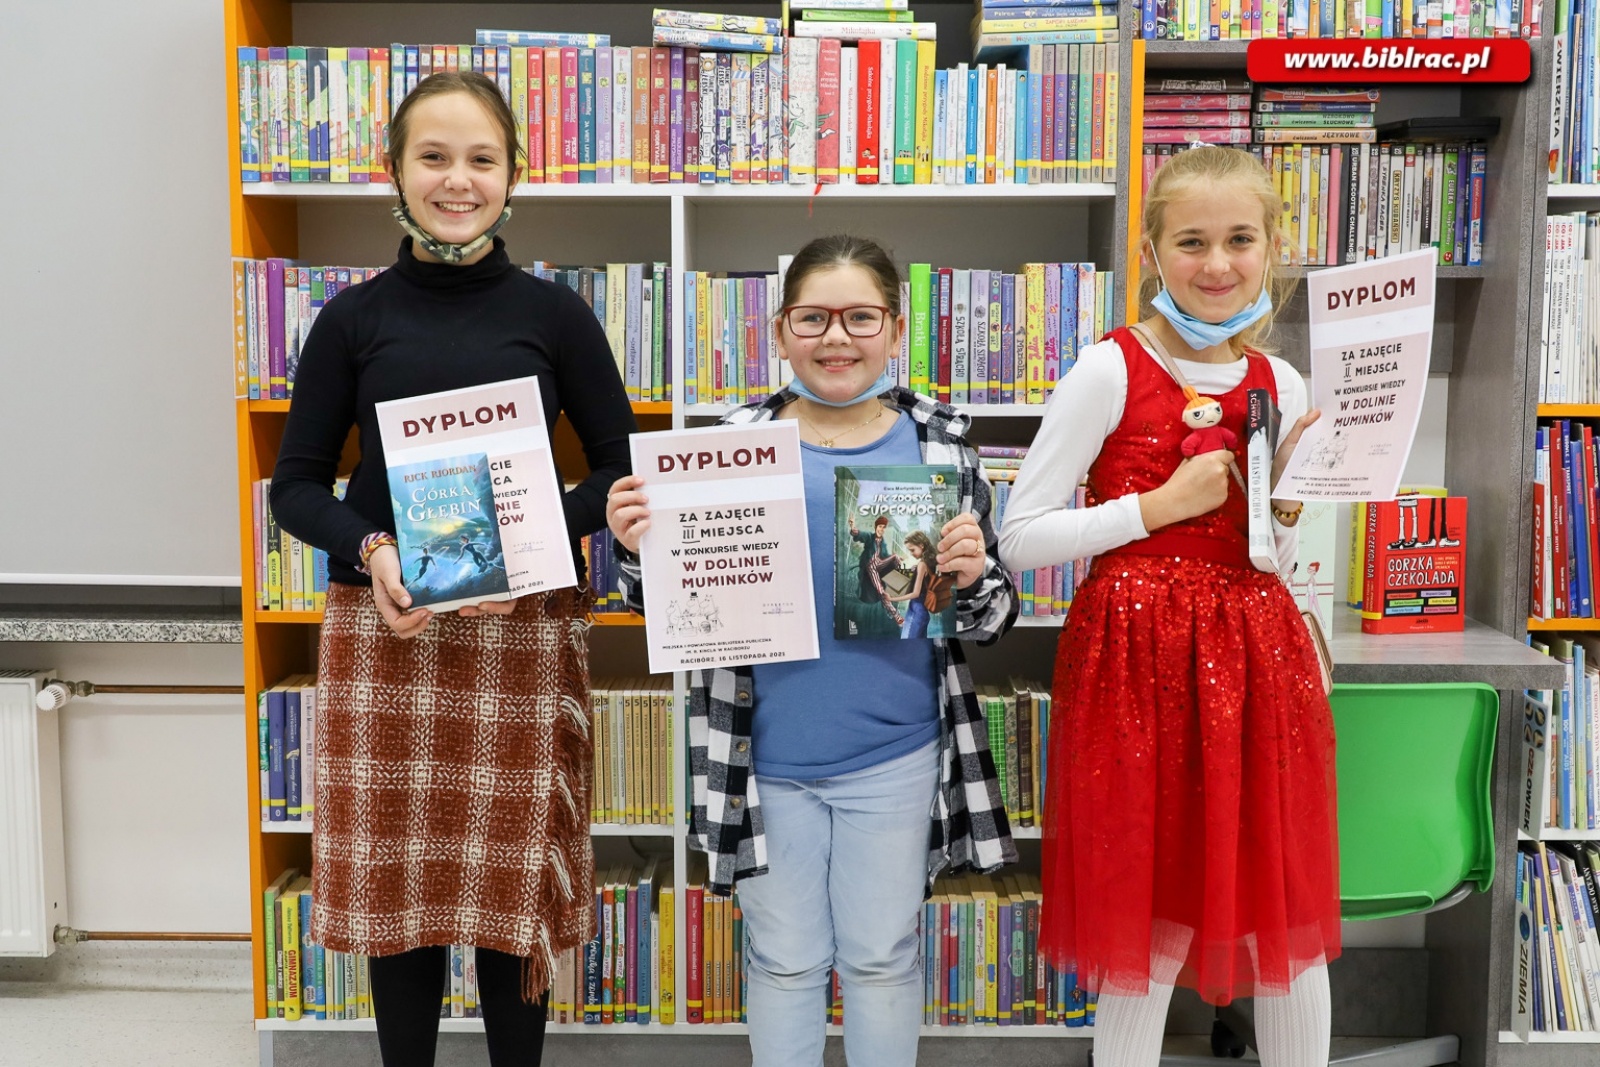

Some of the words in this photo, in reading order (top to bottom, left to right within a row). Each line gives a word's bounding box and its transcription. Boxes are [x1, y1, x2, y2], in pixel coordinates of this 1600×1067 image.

[865, 88, 873, 113] przygody
[1553, 39, 1564, 138] ZWIERZĘTA
[920, 91, 928, 116] przygody
[1069, 98, 1077, 115] życie
[865, 113, 873, 140] Mikołajka
[1321, 131, 1360, 139] JĘZYKOWE
[1069, 137, 1077, 157] NINJA
[1393, 173, 1401, 202] KRYZYS
[1447, 179, 1455, 205] EUREKA
[1392, 203, 1400, 241] KUBAŃSKI
[286, 270, 296, 284] 3
[300, 271, 310, 285] 2
[313, 271, 323, 282] 4
[326, 271, 336, 282] 5
[338, 271, 348, 283] 6
[352, 273, 362, 284] 7
[234, 270, 245, 316] LAT
[1327, 277, 1416, 311] DYPLOM
[697, 310, 705, 326] Milly
[914, 311, 927, 347] Bratki
[955, 316, 966, 344] SZKOŁA
[976, 321, 986, 348] SZKOŁA
[235, 325, 247, 387] 12-14
[1015, 339, 1025, 380] Mariolka
[1029, 336, 1040, 362] Julia
[1045, 336, 1057, 362] Julia
[1064, 336, 1076, 362] Julia
[1341, 350, 1355, 362] ZA
[1359, 343, 1402, 358] ZAJĘCIE
[955, 347, 967, 378] STRACHU
[976, 349, 986, 378] STRACHU
[1355, 361, 1399, 377] MIEJSCA
[1334, 388, 1341, 396] W
[1343, 383, 1379, 395] KONKURSIE
[1380, 379, 1406, 391] WIEDZY
[1250, 393, 1259, 428] SCHWAB
[1340, 400, 1350, 412] W
[1352, 394, 1397, 410] DOLINIE
[402, 401, 518, 438] DYPLOM
[1333, 409, 1395, 428] MUMINKÓW
[658, 446, 777, 473] DYPLOM
[1251, 455, 1261, 486] MIASTO
[404, 471, 428, 484] RICK
[431, 464, 478, 482] RIORDAN
[1564, 466, 1572, 495] TRANSPORT
[412, 486, 474, 505] CÓRKA
[494, 488, 529, 500] WIEDZY
[873, 493, 890, 505] JAK
[890, 491, 933, 504] ZDOBYĆ
[1251, 487, 1263, 519] DUCHÓW
[406, 498, 482, 523] GŁĘBIN
[680, 513, 698, 523] ZA
[705, 506, 766, 521] ZAJĘCIE
[858, 504, 946, 518] SUPERMOCE
[1369, 502, 1378, 534] GORZKA
[700, 524, 765, 539] MIEJSCA
[594, 543, 602, 573] Pogromca
[671, 549, 681, 557] W
[684, 544, 739, 556] KONKURSIE
[742, 541, 780, 551] WIEDZY
[1366, 534, 1376, 580] CZEKOLADA
[1534, 503, 1542, 590] POJAZDY
[682, 561, 698, 572] W
[705, 555, 771, 571] DOLINIE
[1387, 556, 1434, 573] GORZKA
[682, 570, 774, 589] MUMINKÓW
[1387, 570, 1456, 588] CZEKOLADA
[729, 652, 767, 662] LISTOPADA
[769, 651, 786, 659] 2021
[594, 698, 601, 706] 2
[625, 699, 630, 707] 5
[634, 698, 640, 706] 5
[643, 699, 648, 708] 5
[667, 699, 672, 707] 6
[1523, 748, 1535, 832] CZŁOWIEK
[1583, 867, 1597, 896] OCEANY
[1591, 897, 1599, 914] ATLAS
[267, 945, 275, 981] PATERSON
[288, 949, 298, 998] GIMNAZJUM
[1518, 943, 1528, 1016] ZIEMIA
[1585, 968, 1598, 1003] WULKANY
